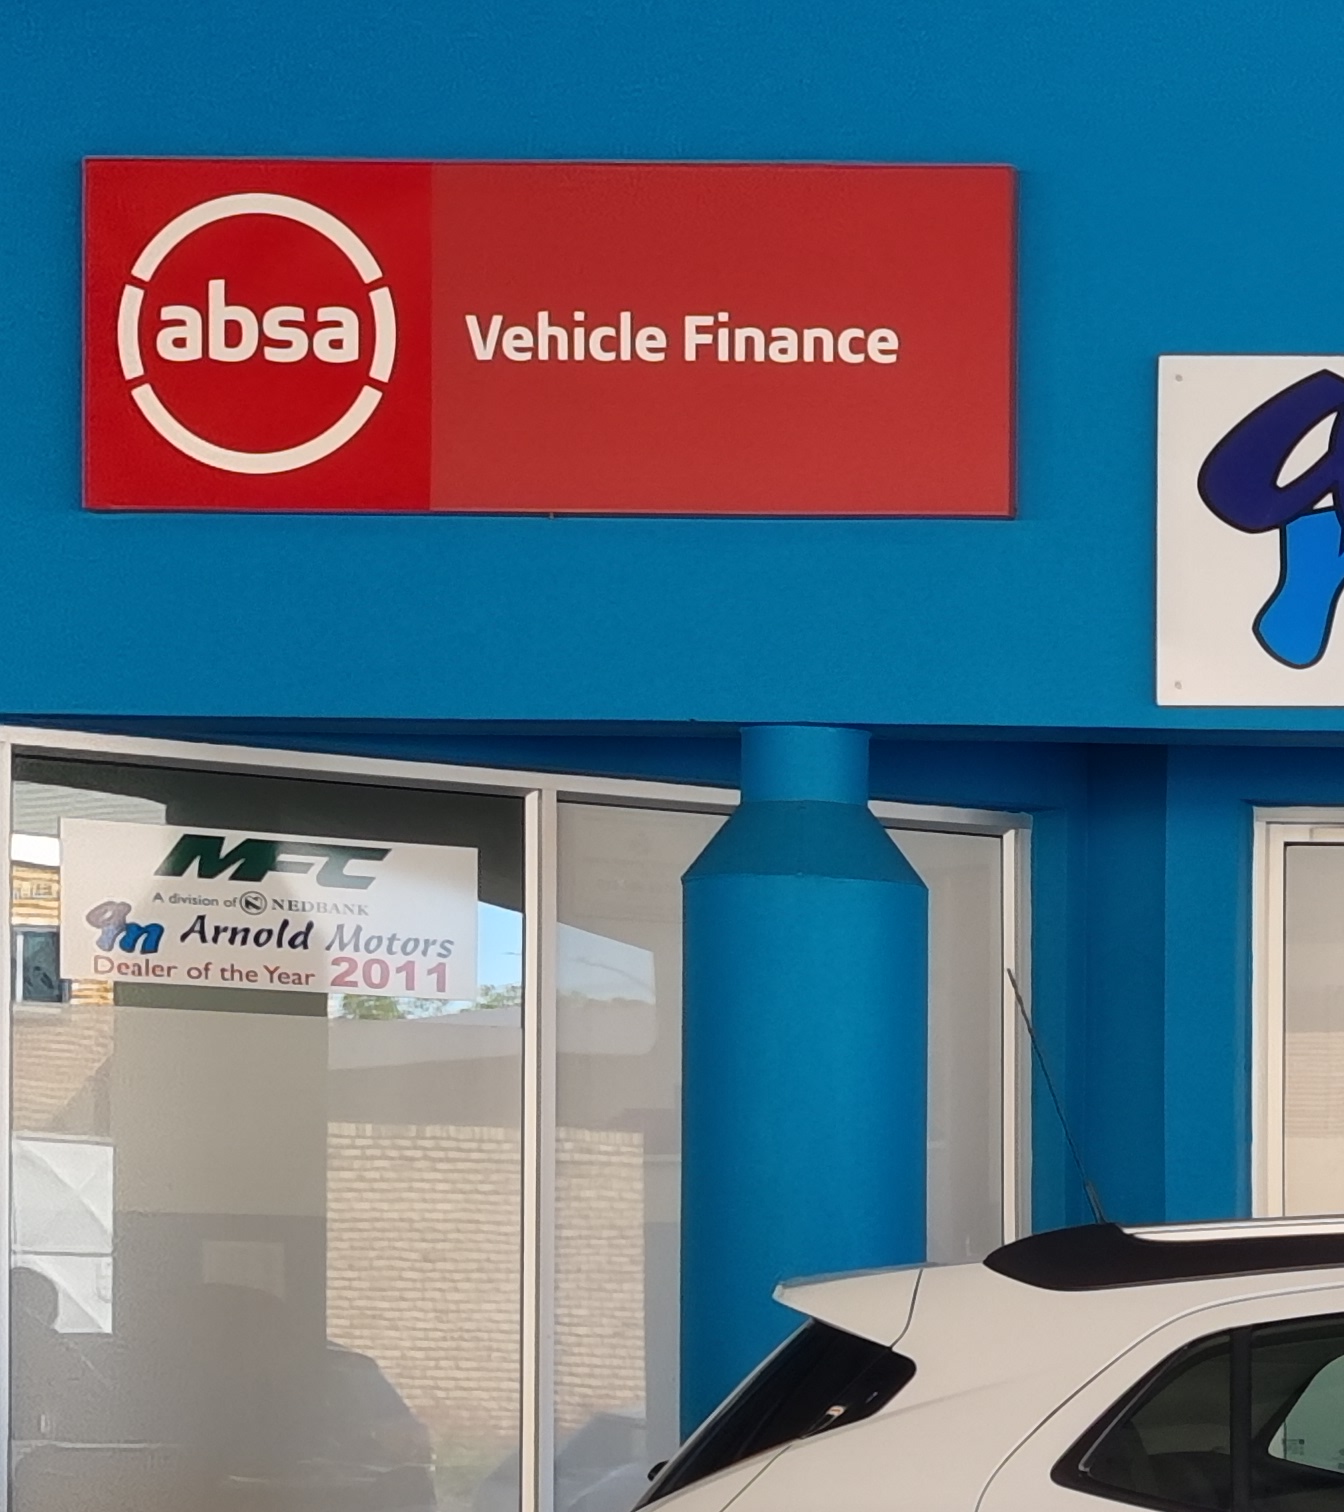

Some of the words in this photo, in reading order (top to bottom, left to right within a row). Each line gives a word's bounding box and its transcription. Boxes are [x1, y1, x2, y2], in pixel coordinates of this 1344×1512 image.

[156, 279, 359, 363] absa
[465, 310, 668, 363] Vehicle
[685, 311, 899, 364] Finance
[154, 833, 393, 890] MFC
[151, 892, 165, 904] A
[168, 893, 220, 907] division
[223, 896, 239, 908] of
[271, 898, 370, 917] NEDBANK
[179, 914, 315, 952] Arnold
[325, 923, 455, 960] Motors
[93, 954, 179, 979] Dealer
[186, 961, 214, 980] of
[219, 962, 259, 984] the
[261, 964, 316, 986] Year
[329, 955, 448, 994] 2011
